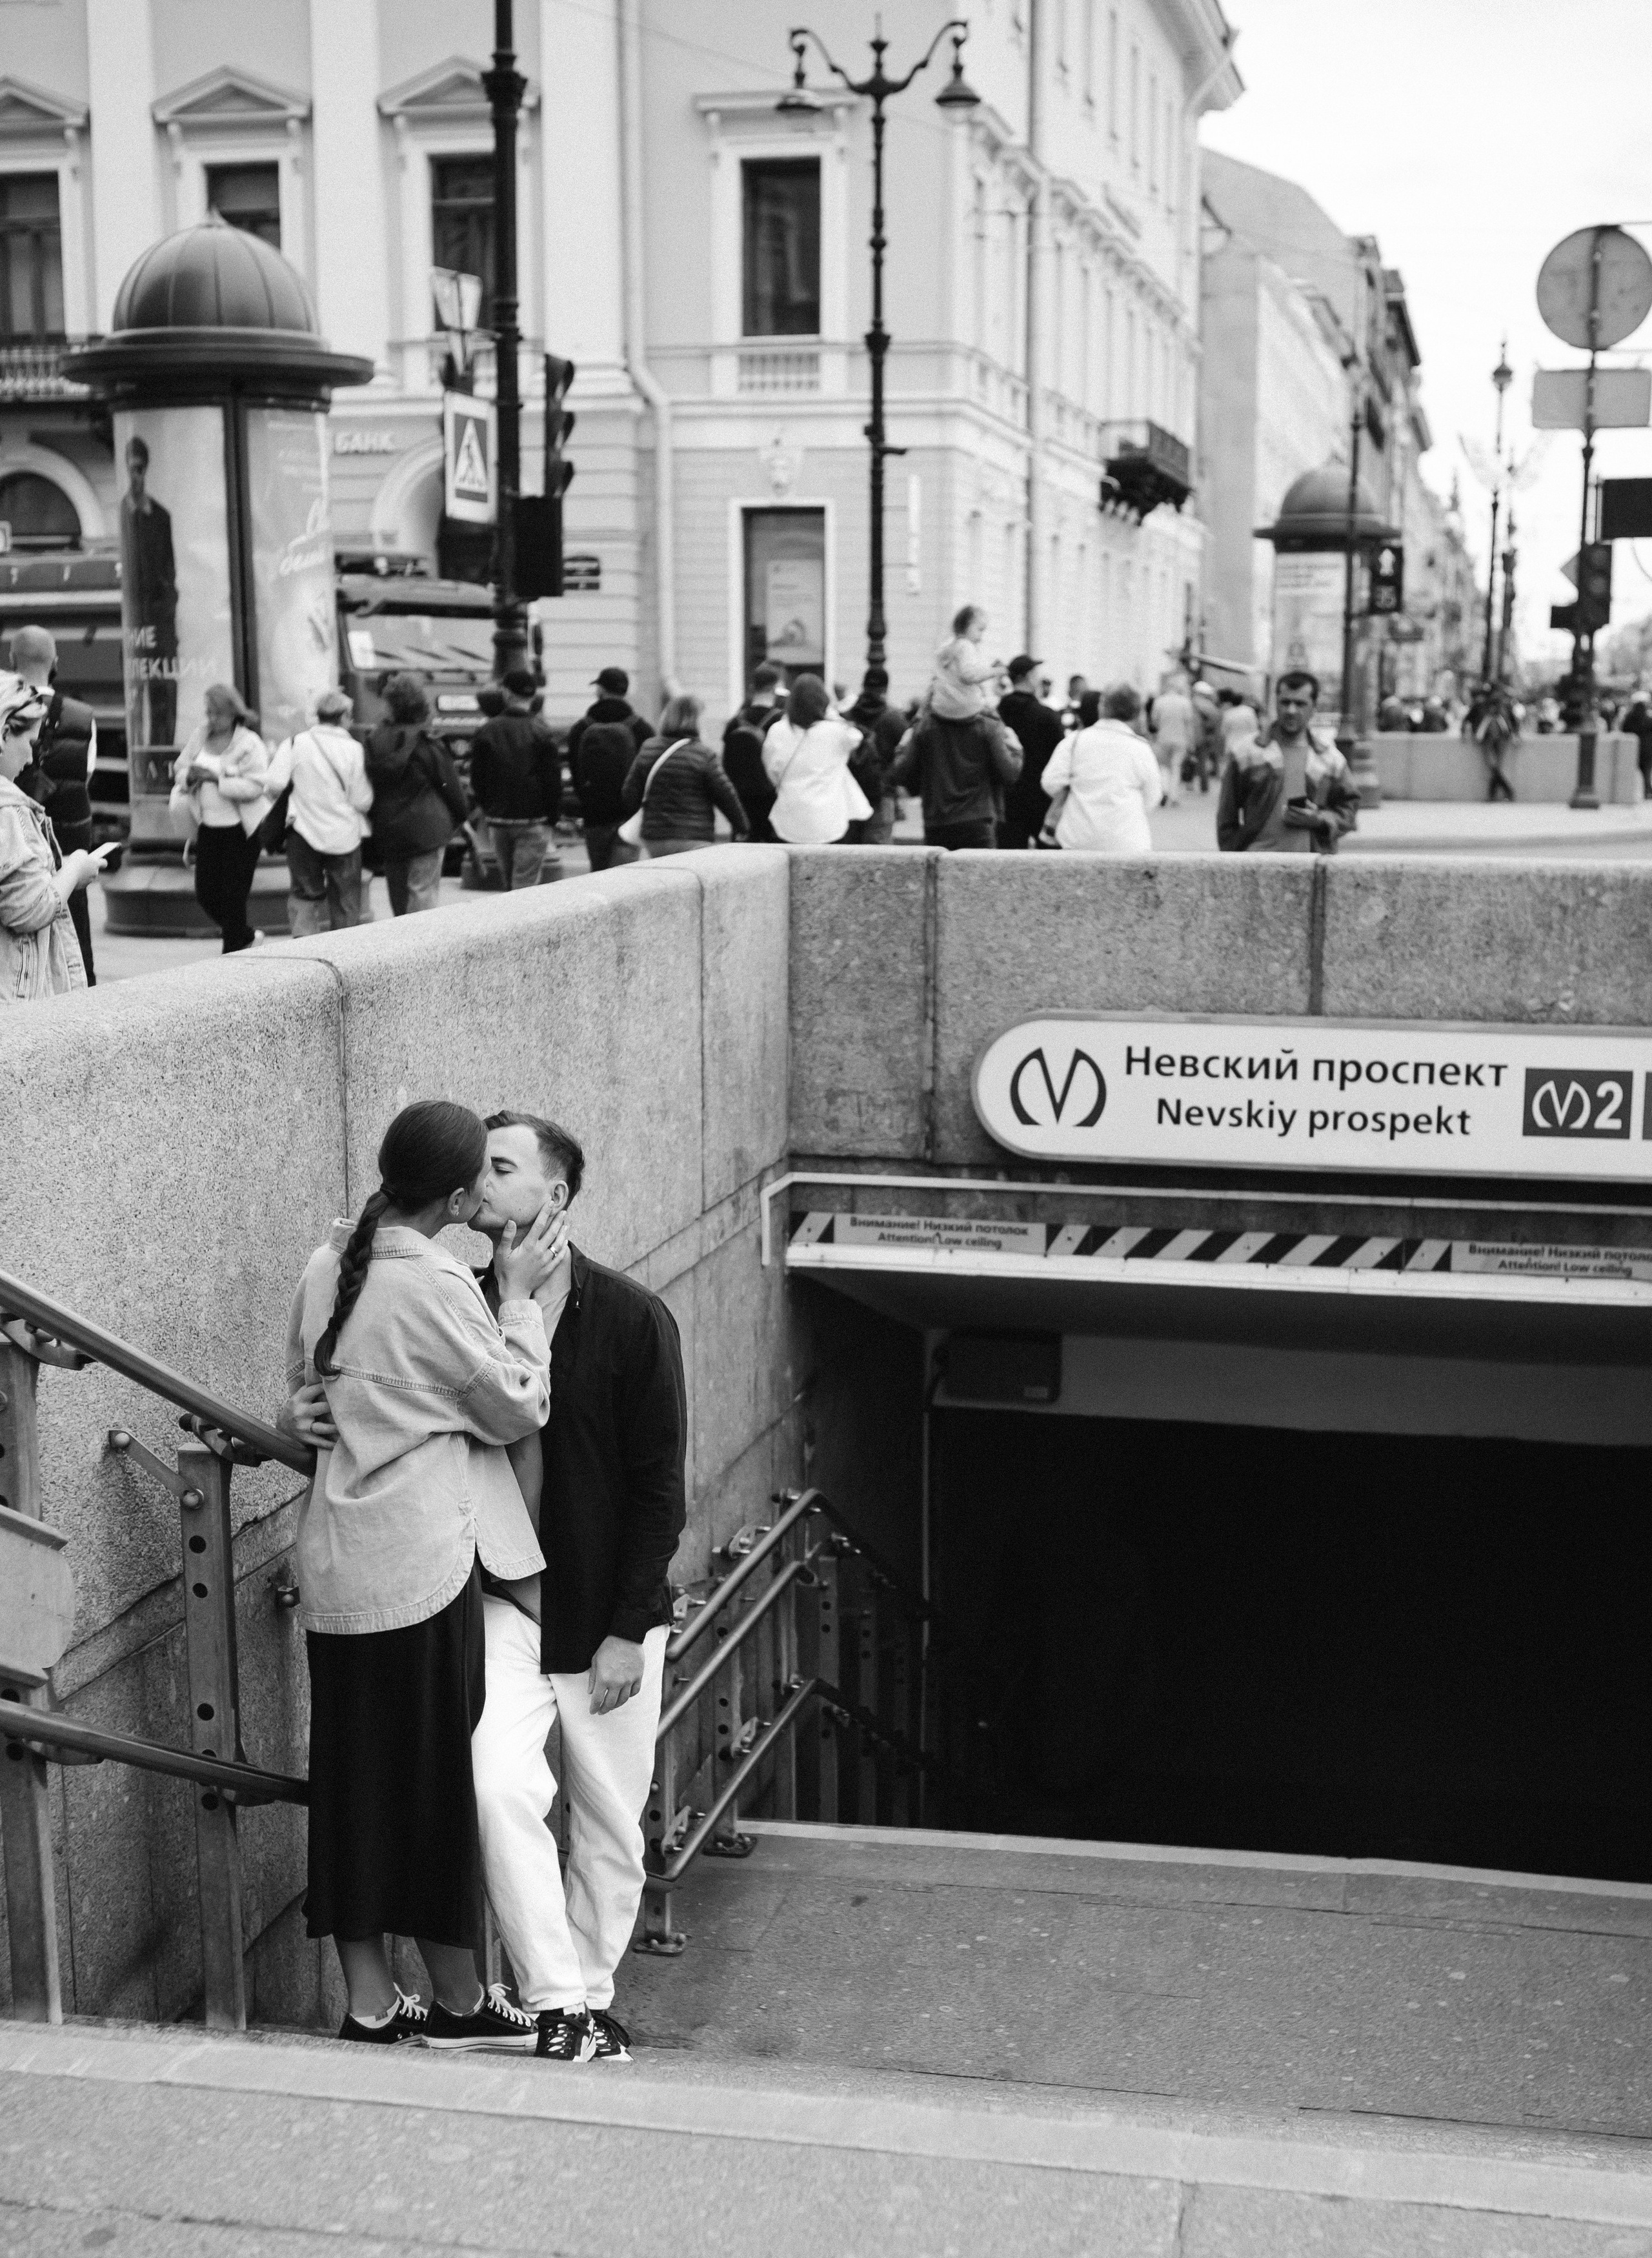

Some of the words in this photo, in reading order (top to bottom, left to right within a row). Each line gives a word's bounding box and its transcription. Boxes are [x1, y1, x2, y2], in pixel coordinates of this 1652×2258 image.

[1126, 1045, 1297, 1080] Невский
[1313, 1059, 1508, 1091] проспект
[1157, 1098, 1297, 1136] Nevskiy
[1309, 1105, 1471, 1140] prospekt
[850, 1216, 920, 1229] Внимание!
[924, 1220, 972, 1233] Низкий
[976, 1224, 1028, 1236] потолок
[966, 1237, 1001, 1251] ceiling
